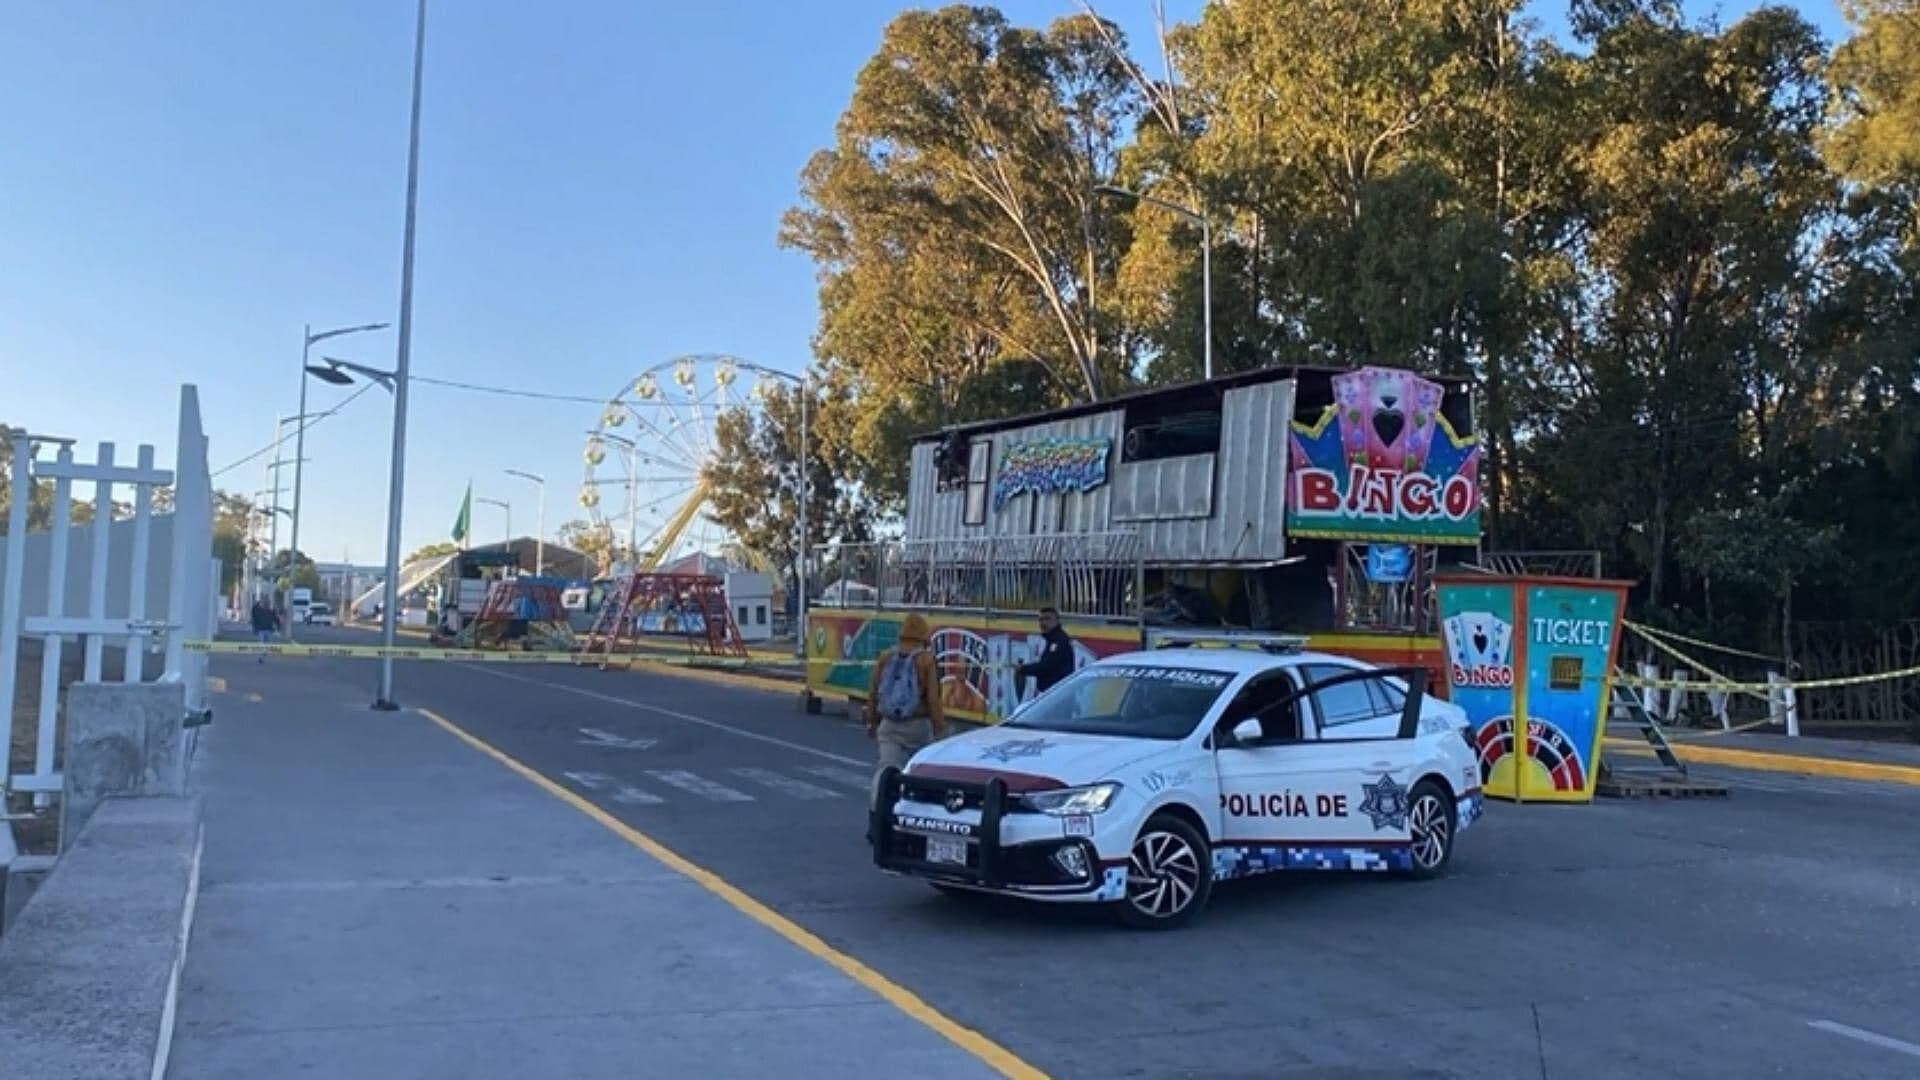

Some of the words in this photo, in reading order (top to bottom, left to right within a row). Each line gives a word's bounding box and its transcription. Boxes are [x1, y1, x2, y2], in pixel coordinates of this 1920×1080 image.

[1297, 465, 1470, 521] BINGO
[1533, 618, 1609, 646] TICKET
[1451, 664, 1513, 687] BINGO
[1316, 794, 1349, 817] DE
